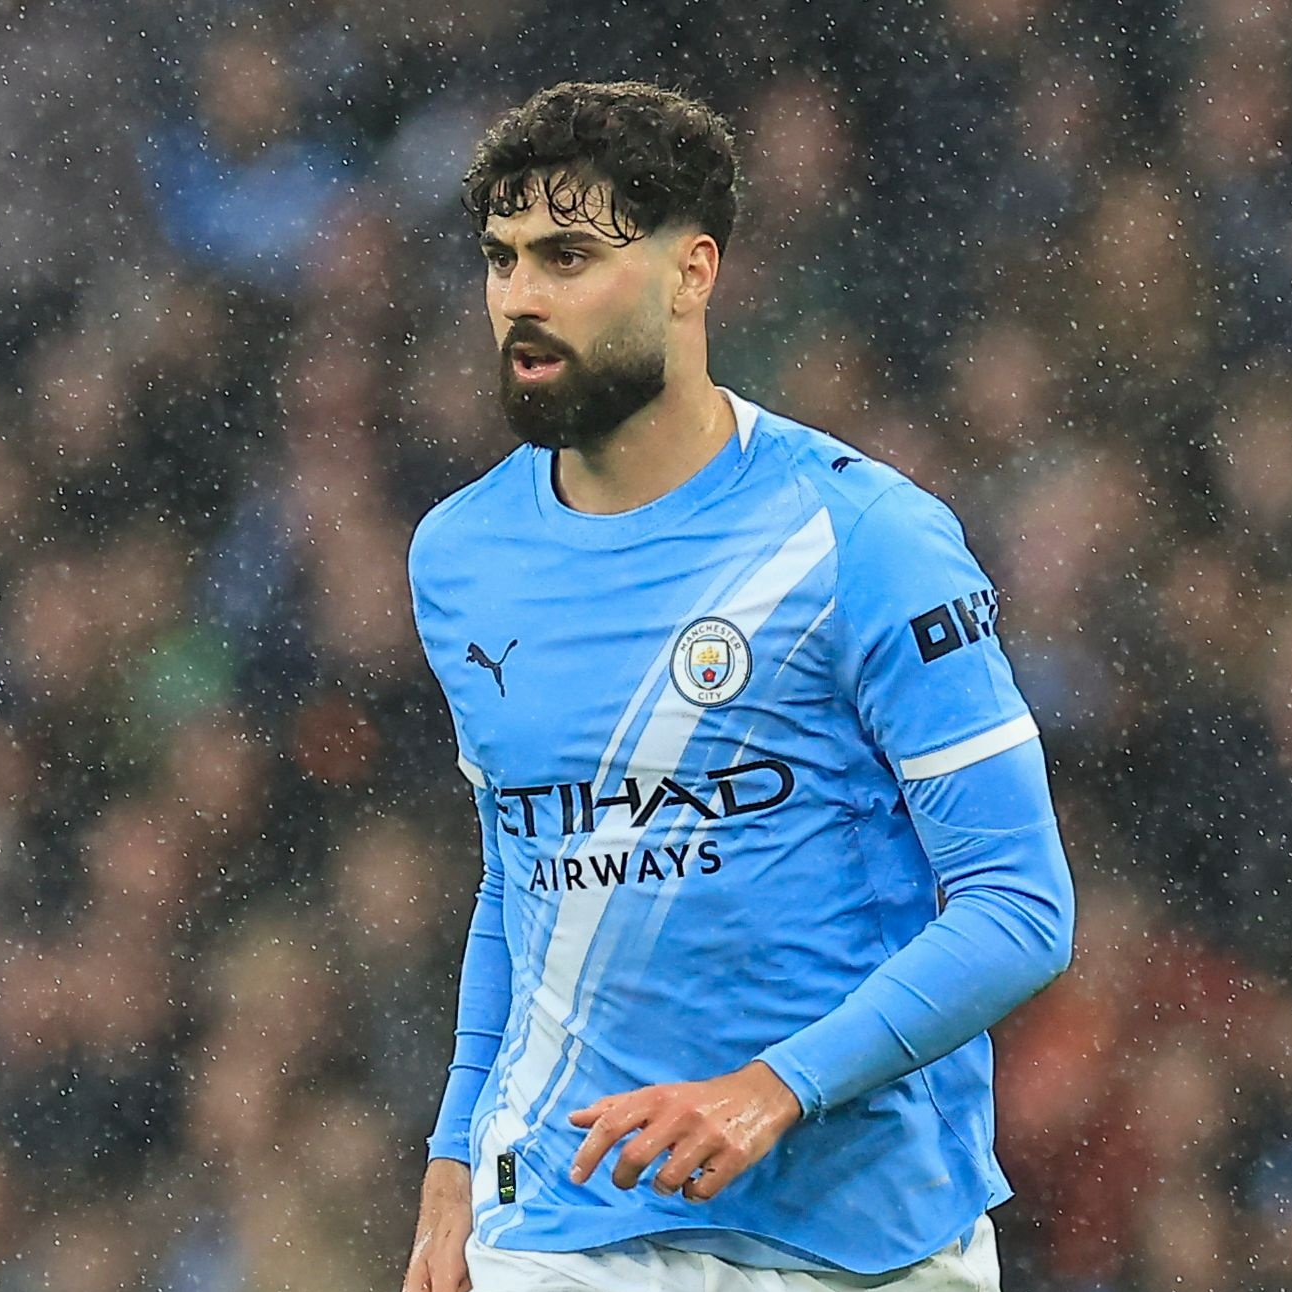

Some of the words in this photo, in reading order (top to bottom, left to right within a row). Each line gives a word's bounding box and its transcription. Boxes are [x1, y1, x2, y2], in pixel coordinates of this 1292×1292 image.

[680, 624, 742, 652] MANCHESTER
[697, 691, 722, 700] CITY
[529, 840, 722, 892] AIRWAYS
